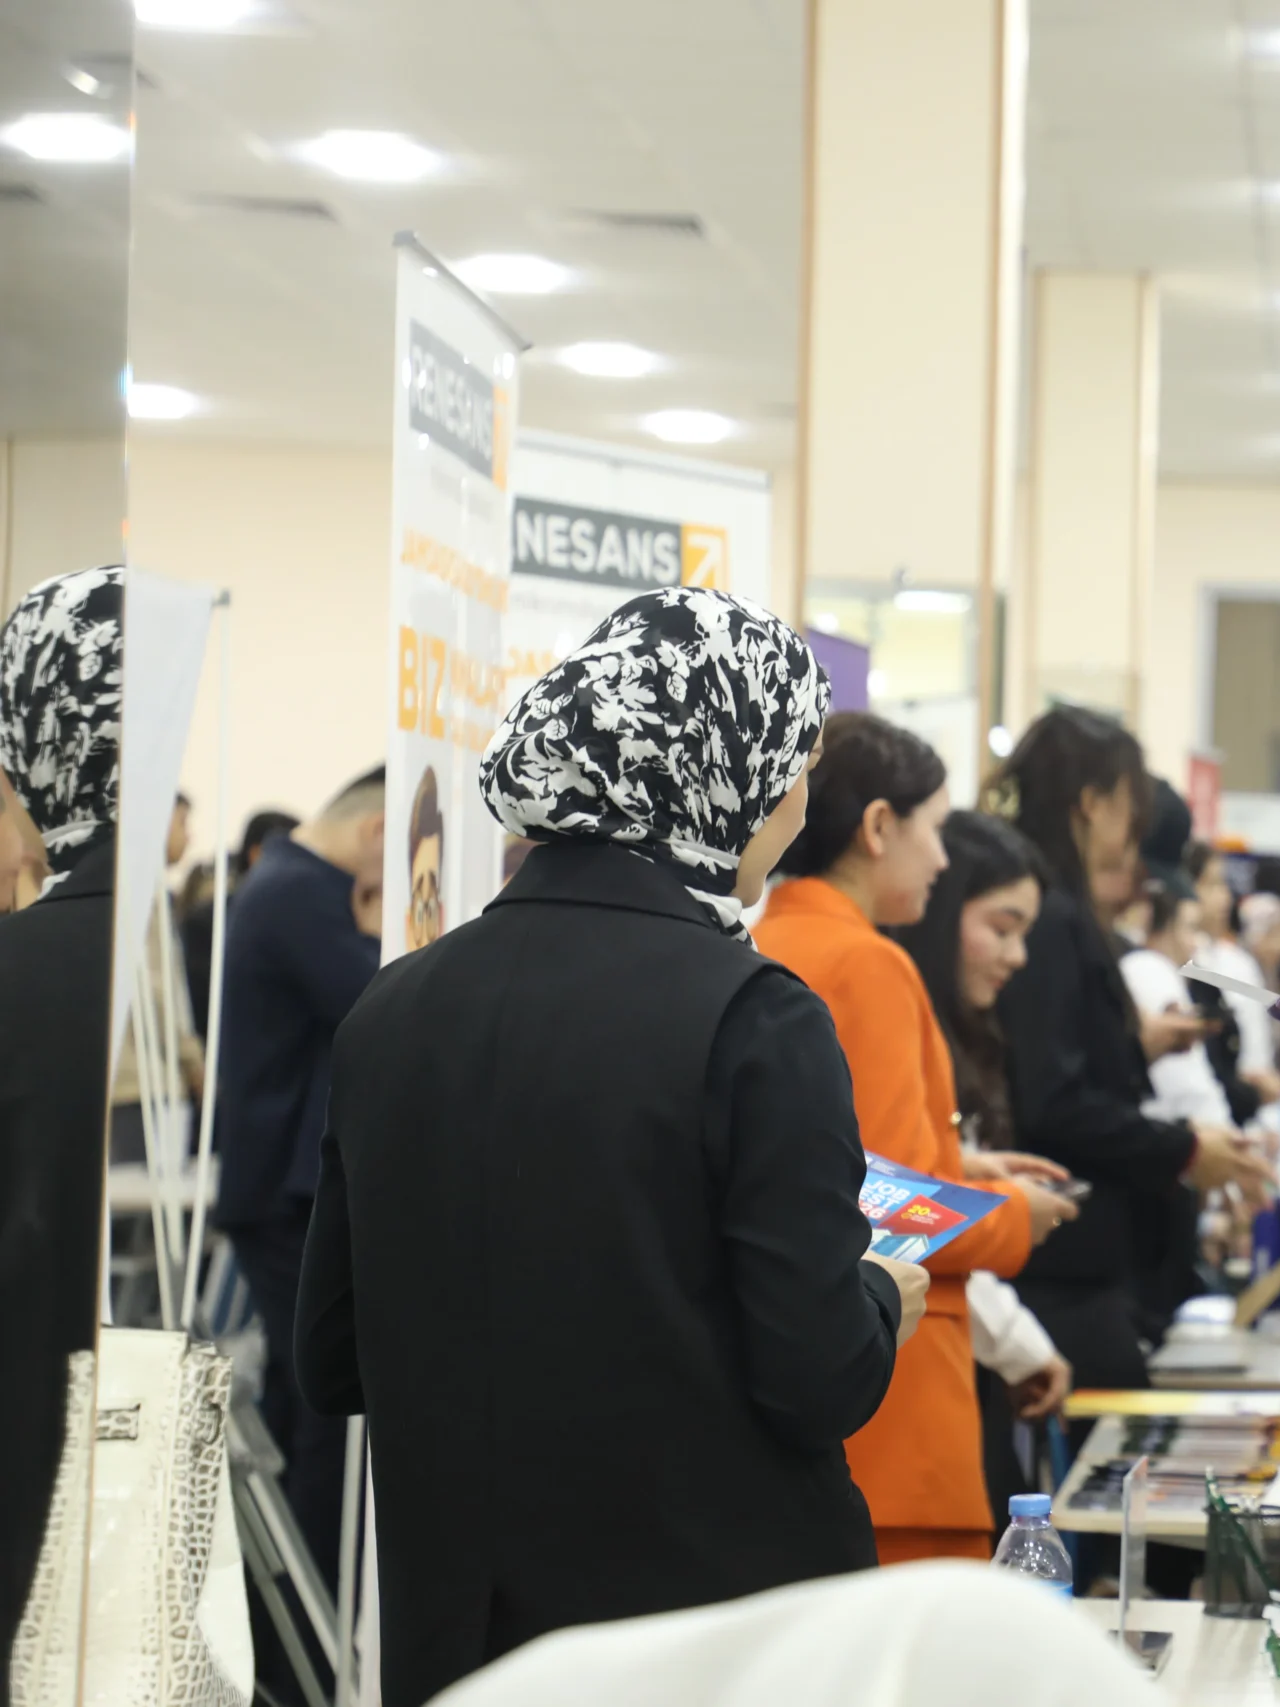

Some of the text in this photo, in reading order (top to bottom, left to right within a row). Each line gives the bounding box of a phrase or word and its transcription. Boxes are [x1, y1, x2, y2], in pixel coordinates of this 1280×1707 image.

[514, 509, 680, 586] NESANS
[397, 624, 447, 740] BIZ
[859, 1187, 900, 1209] EST
[865, 1180, 911, 1201] JOB
